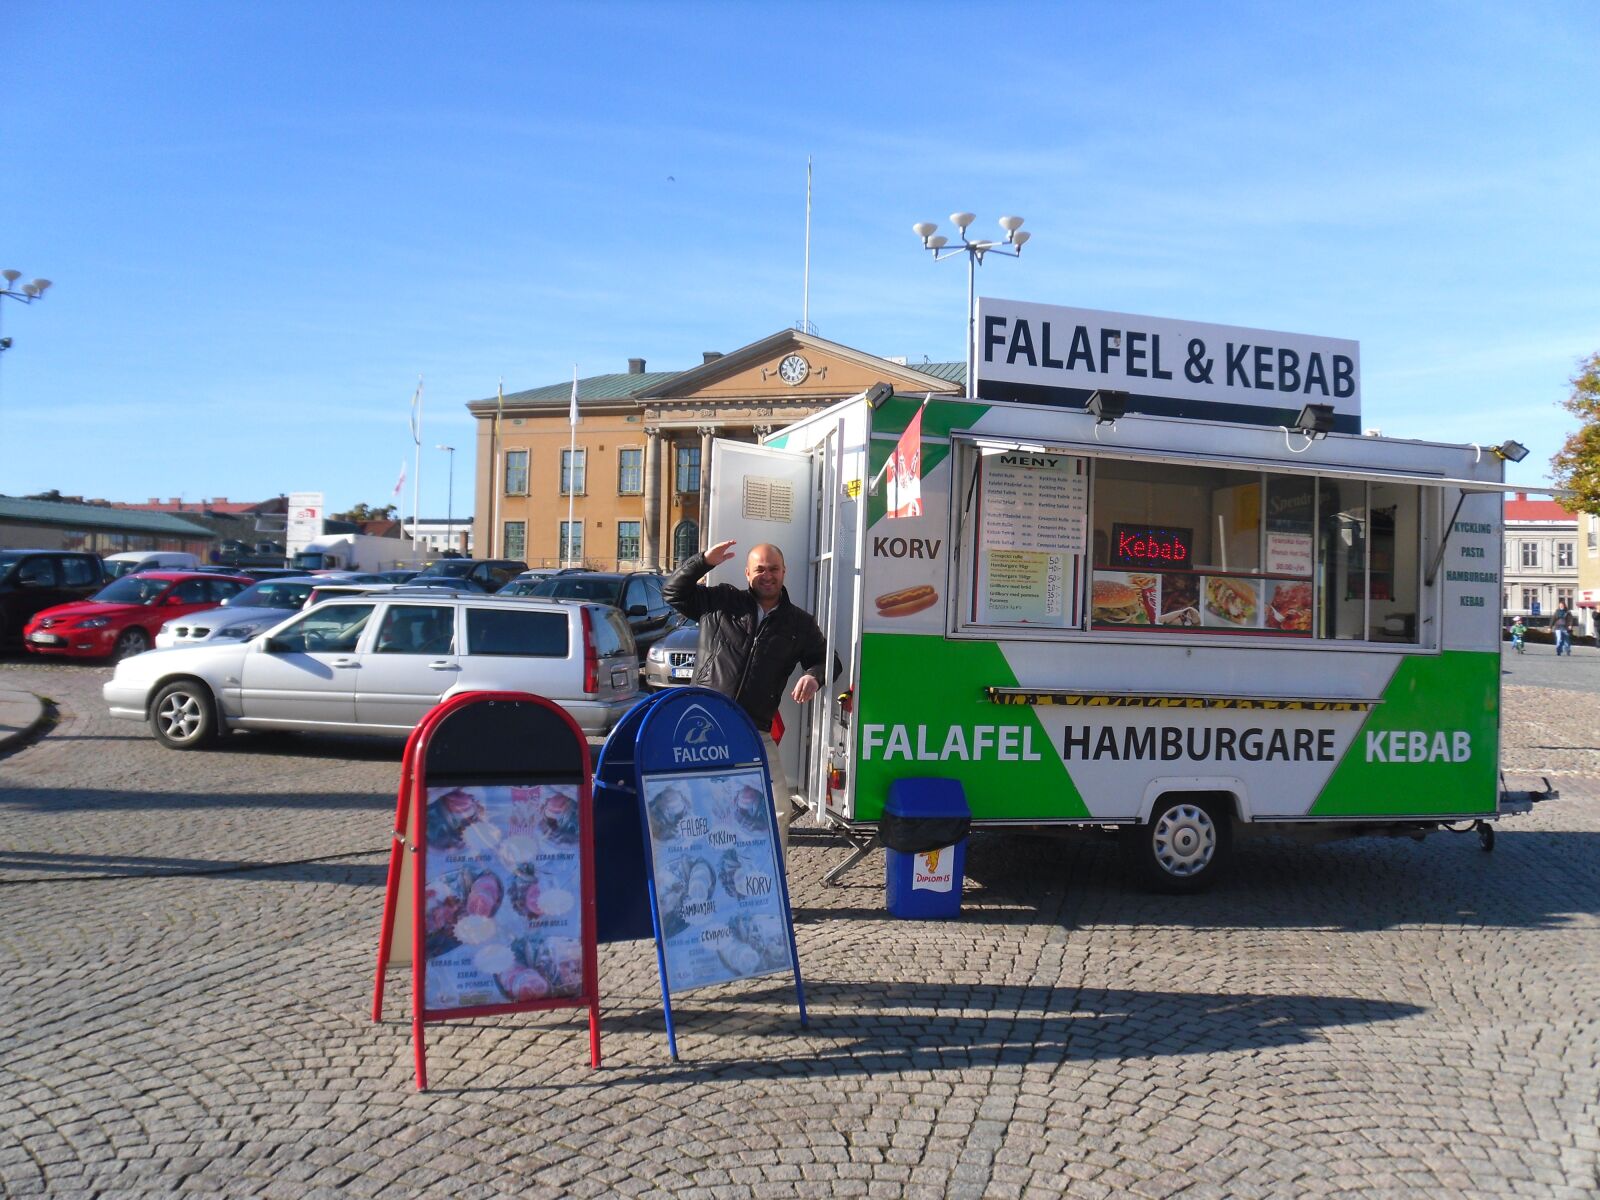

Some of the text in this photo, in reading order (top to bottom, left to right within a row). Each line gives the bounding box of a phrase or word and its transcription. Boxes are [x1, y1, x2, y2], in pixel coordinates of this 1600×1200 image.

[984, 315, 1355, 398] FALAFEL & KEBAB
[1000, 455, 1058, 467] MENY
[1454, 522, 1491, 534] KYCKLING
[873, 537, 942, 559] KORV
[1119, 531, 1187, 560] Kebab
[1461, 546, 1485, 558] PASTA
[1446, 570, 1498, 583] HAMBURGARE
[1460, 595, 1485, 607] KEBAB
[862, 724, 1041, 761] FALAFEL
[1063, 725, 1336, 761] HAMBURGARE
[1366, 731, 1472, 763] KEBAB
[672, 745, 730, 763] FALCON
[746, 876, 772, 896] KORV
